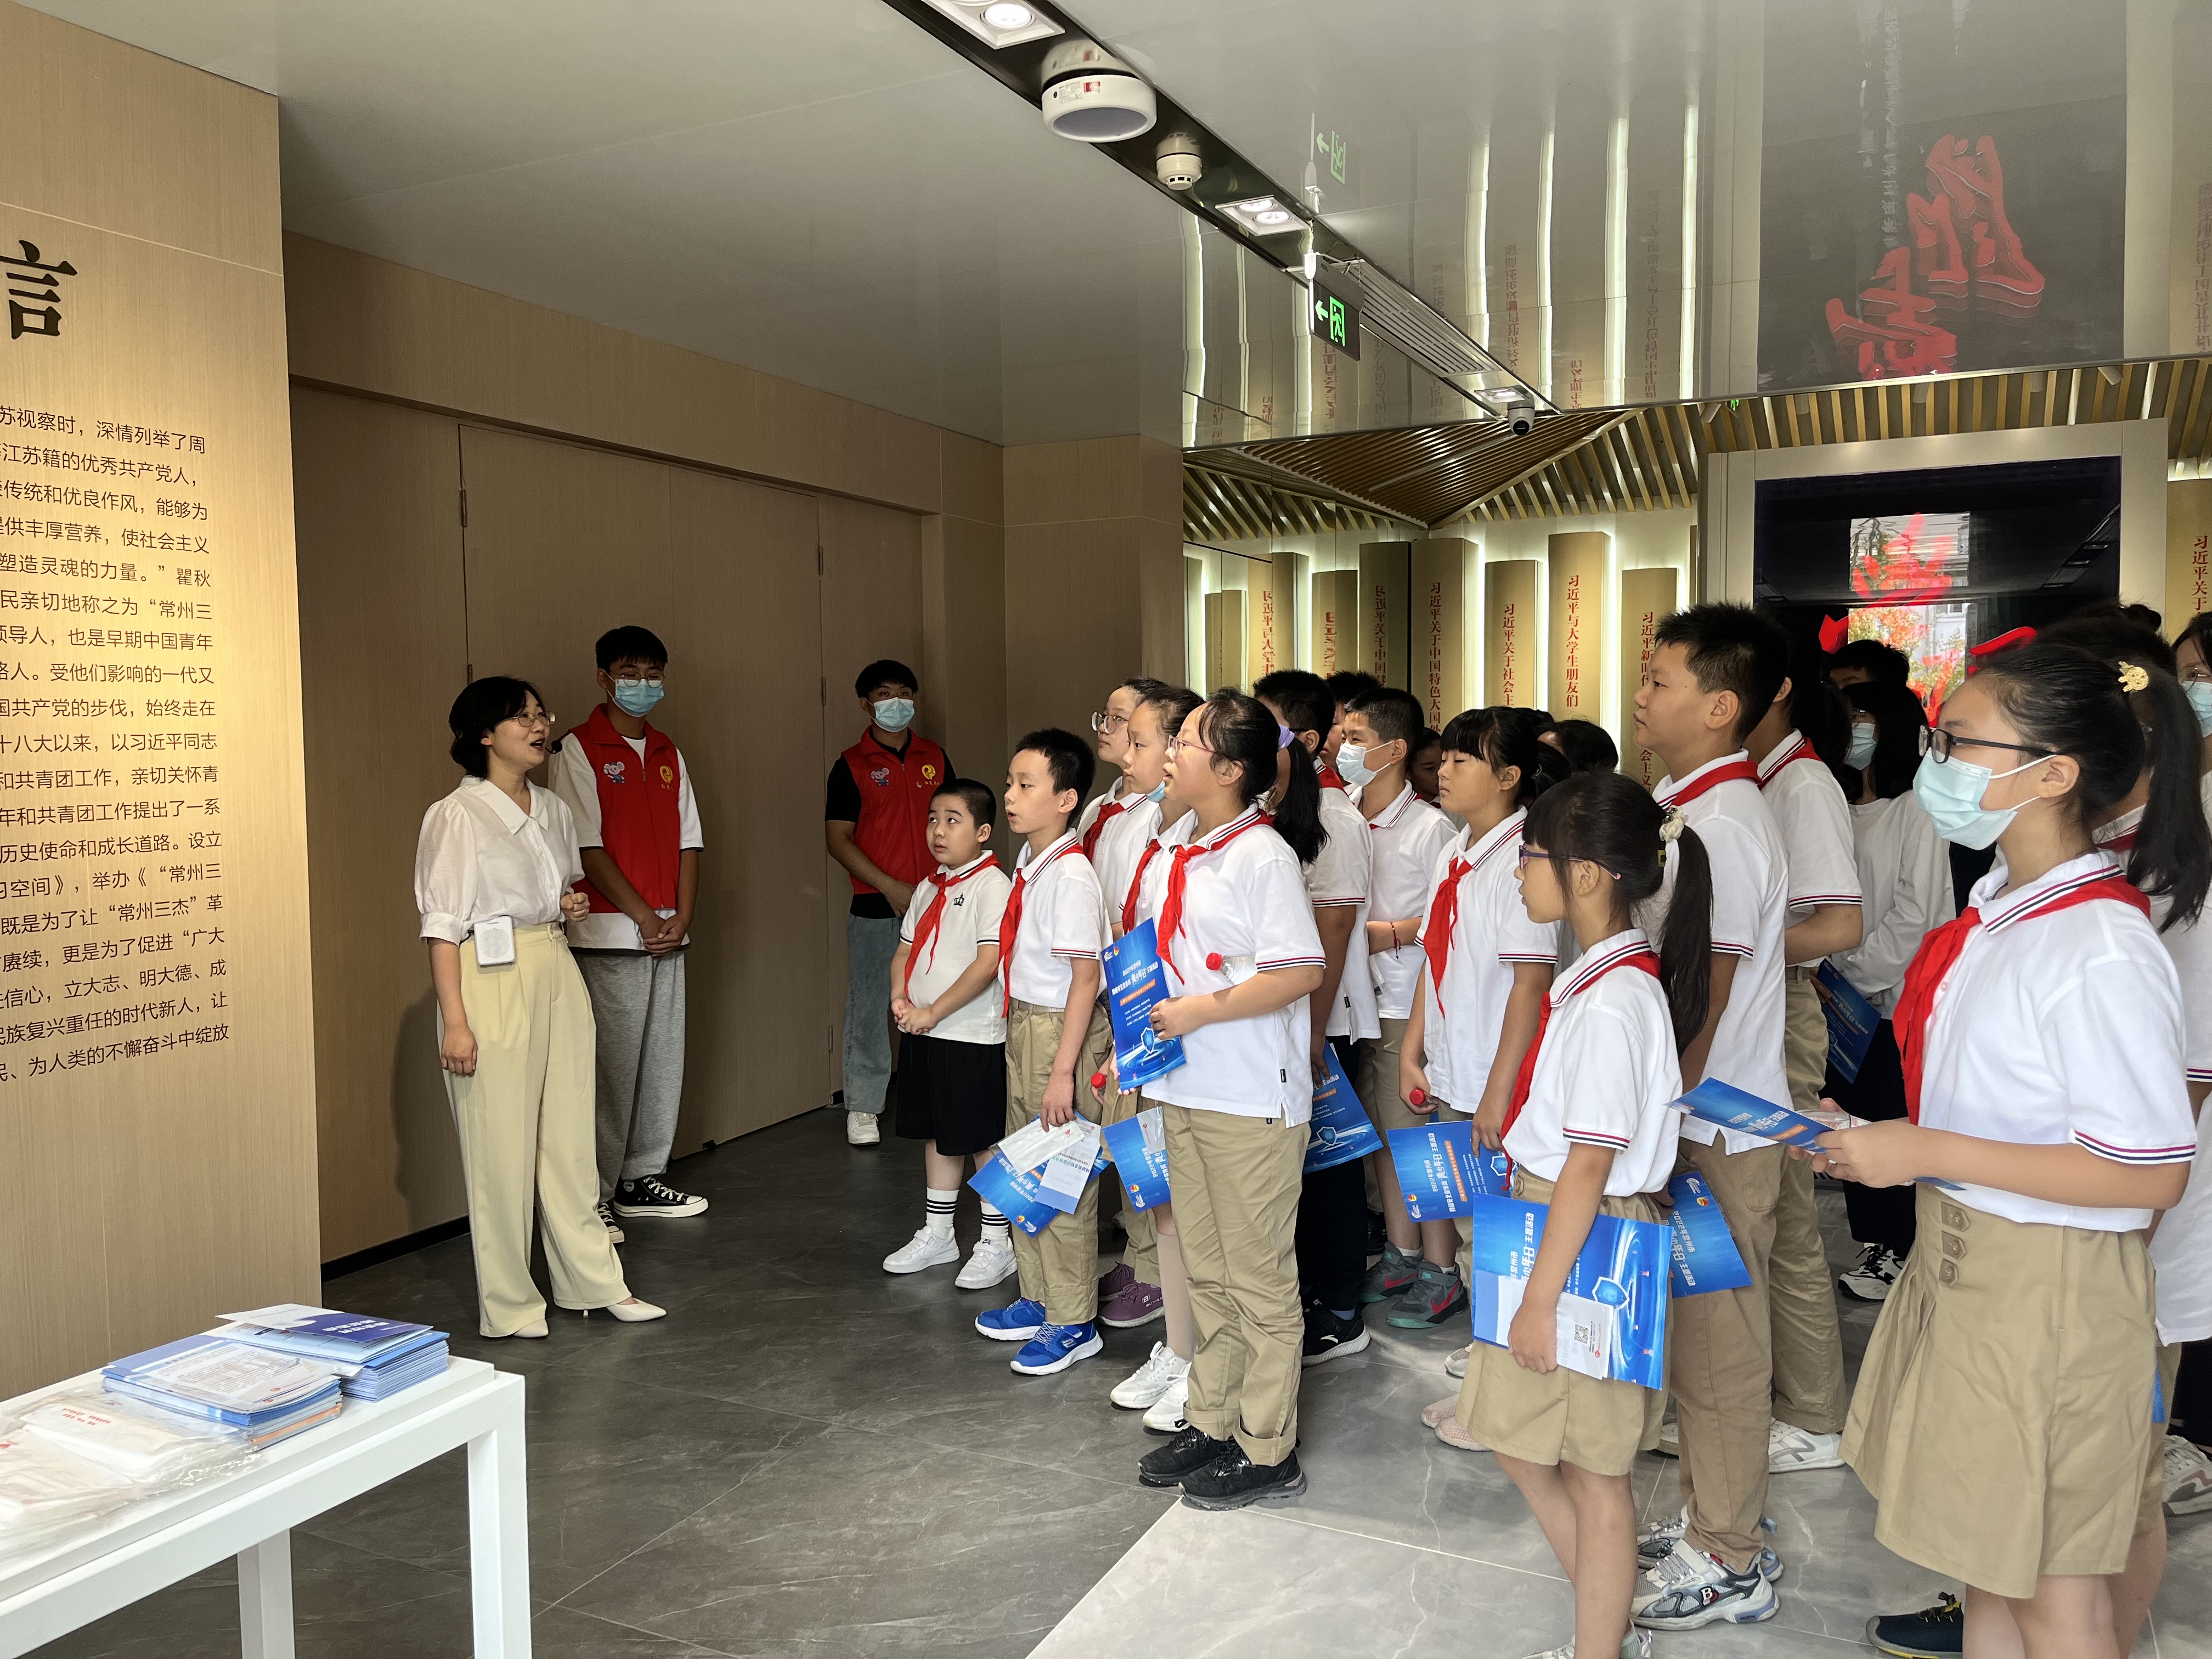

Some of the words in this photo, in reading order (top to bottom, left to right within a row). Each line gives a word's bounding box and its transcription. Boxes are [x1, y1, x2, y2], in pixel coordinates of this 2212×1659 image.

[0, 240, 77, 340] 言
[0, 442, 199, 487] 江苏籍的优秀共产党人，
[0, 480, 207, 521] 传统和优良作风，能够为
[0, 516, 210, 555] 供丰厚营养，使社会主义
[2192, 535, 2208, 616] 习近平关于
[1503, 603, 1515, 706] 习近平关于社会主
[1566, 575, 1579, 707] 习近平与大学生朋友们
[0, 927, 225, 972] 赓续，更是为了促进“广大
[0, 959, 227, 1009] 信心，立大志、明大德、成
